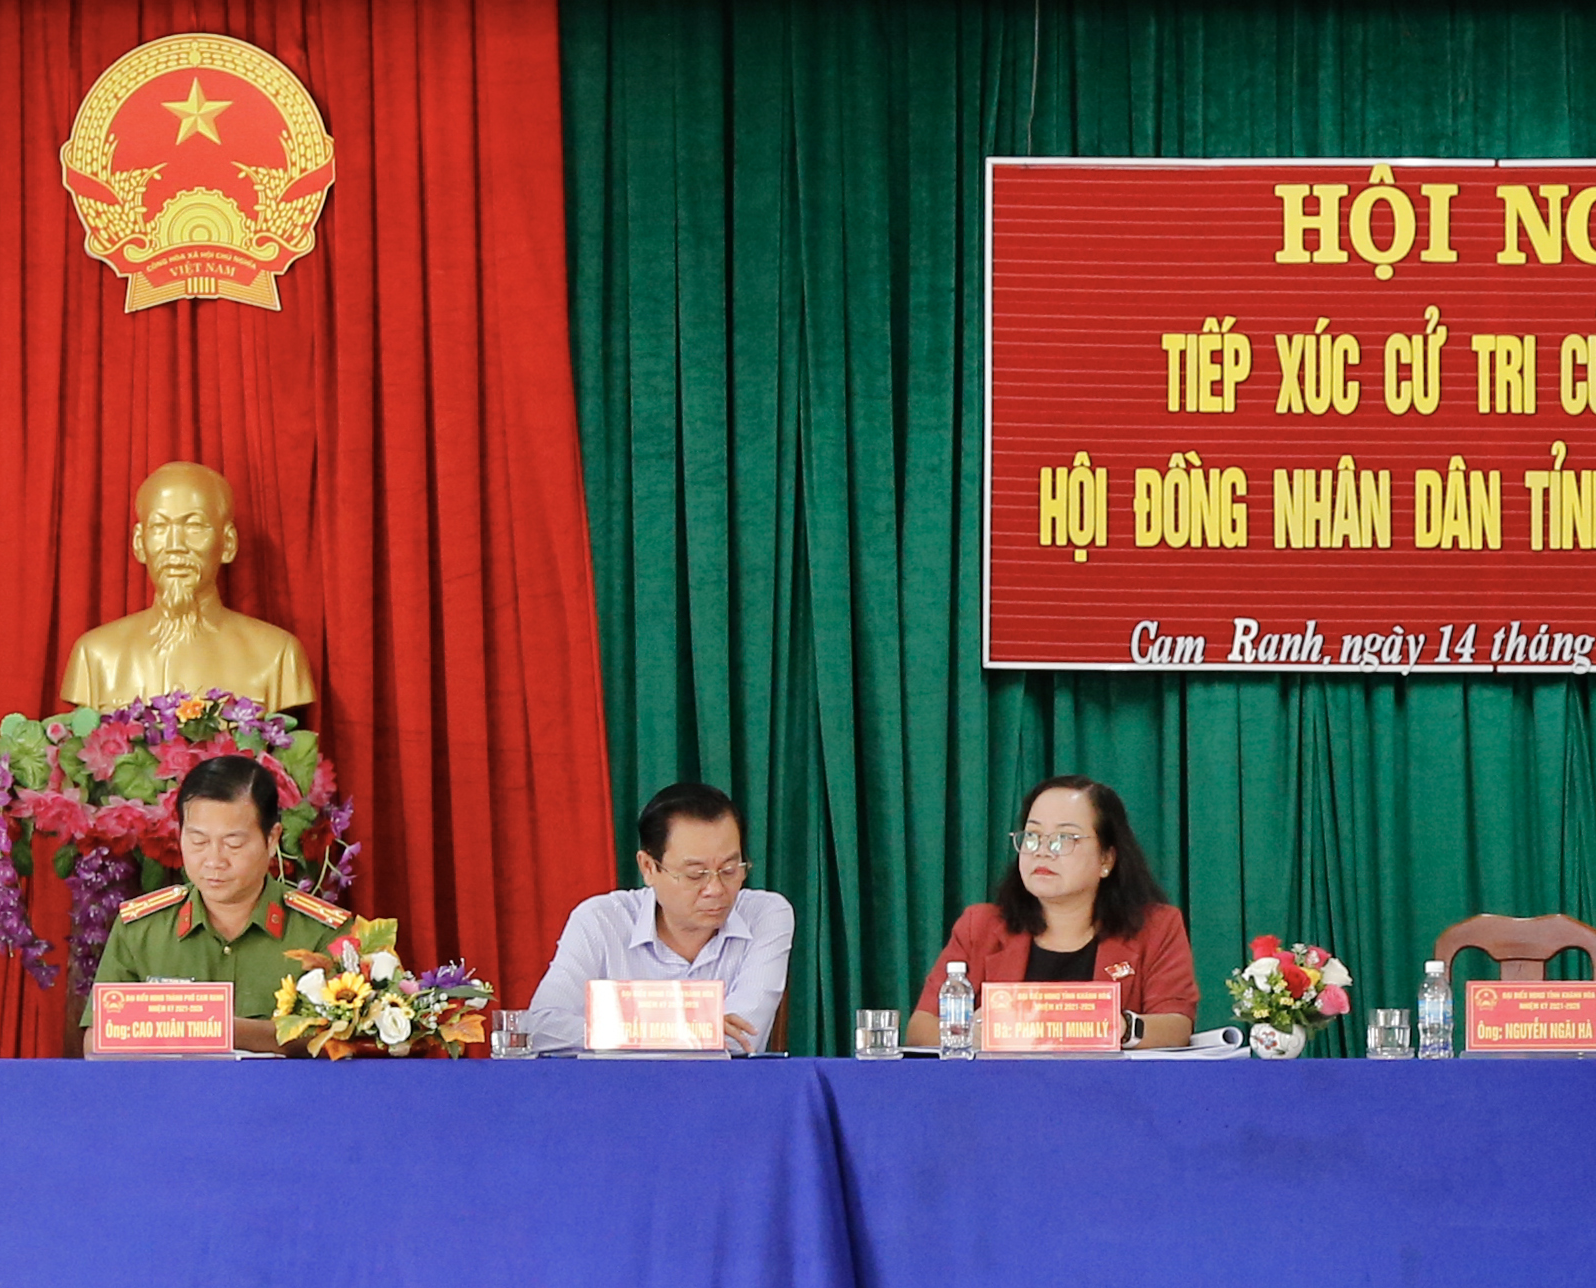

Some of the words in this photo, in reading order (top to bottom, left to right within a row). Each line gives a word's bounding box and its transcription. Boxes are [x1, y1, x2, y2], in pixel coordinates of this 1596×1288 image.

[1274, 163, 1458, 280] HỘI
[169, 260, 202, 276] VIỆT
[206, 262, 235, 277] NAM
[1161, 316, 1252, 413] TIẾP
[1274, 316, 1361, 415] XÚC
[1384, 305, 1448, 415] CỬ
[1471, 334, 1536, 414] TRI
[1039, 451, 1108, 563] HỘI
[1133, 450, 1248, 548] ĐỒNG
[1273, 454, 1391, 549] NHÂN
[1415, 454, 1502, 550] DÂN
[1129, 620, 1205, 664] Cam
[1230, 618, 1331, 667] Ranh,
[1339, 624, 1426, 675] ngày
[1434, 624, 1476, 663] 14
[1491, 625, 1592, 674] tháng
[105, 1019, 131, 1039] Ông:
[132, 1021, 153, 1038] CAO
[156, 1018, 185, 1038] XUÂN
[187, 1015, 222, 1038] THUẤN
[993, 1022, 1012, 1038] Bà:
[1046, 1021, 1063, 1042] THỊ
[1065, 1022, 1094, 1038] MINH
[1096, 1018, 1109, 1038] LÝ
[1477, 1020, 1502, 1041] Ông:
[1505, 1016, 1547, 1039] NGUYỄN
